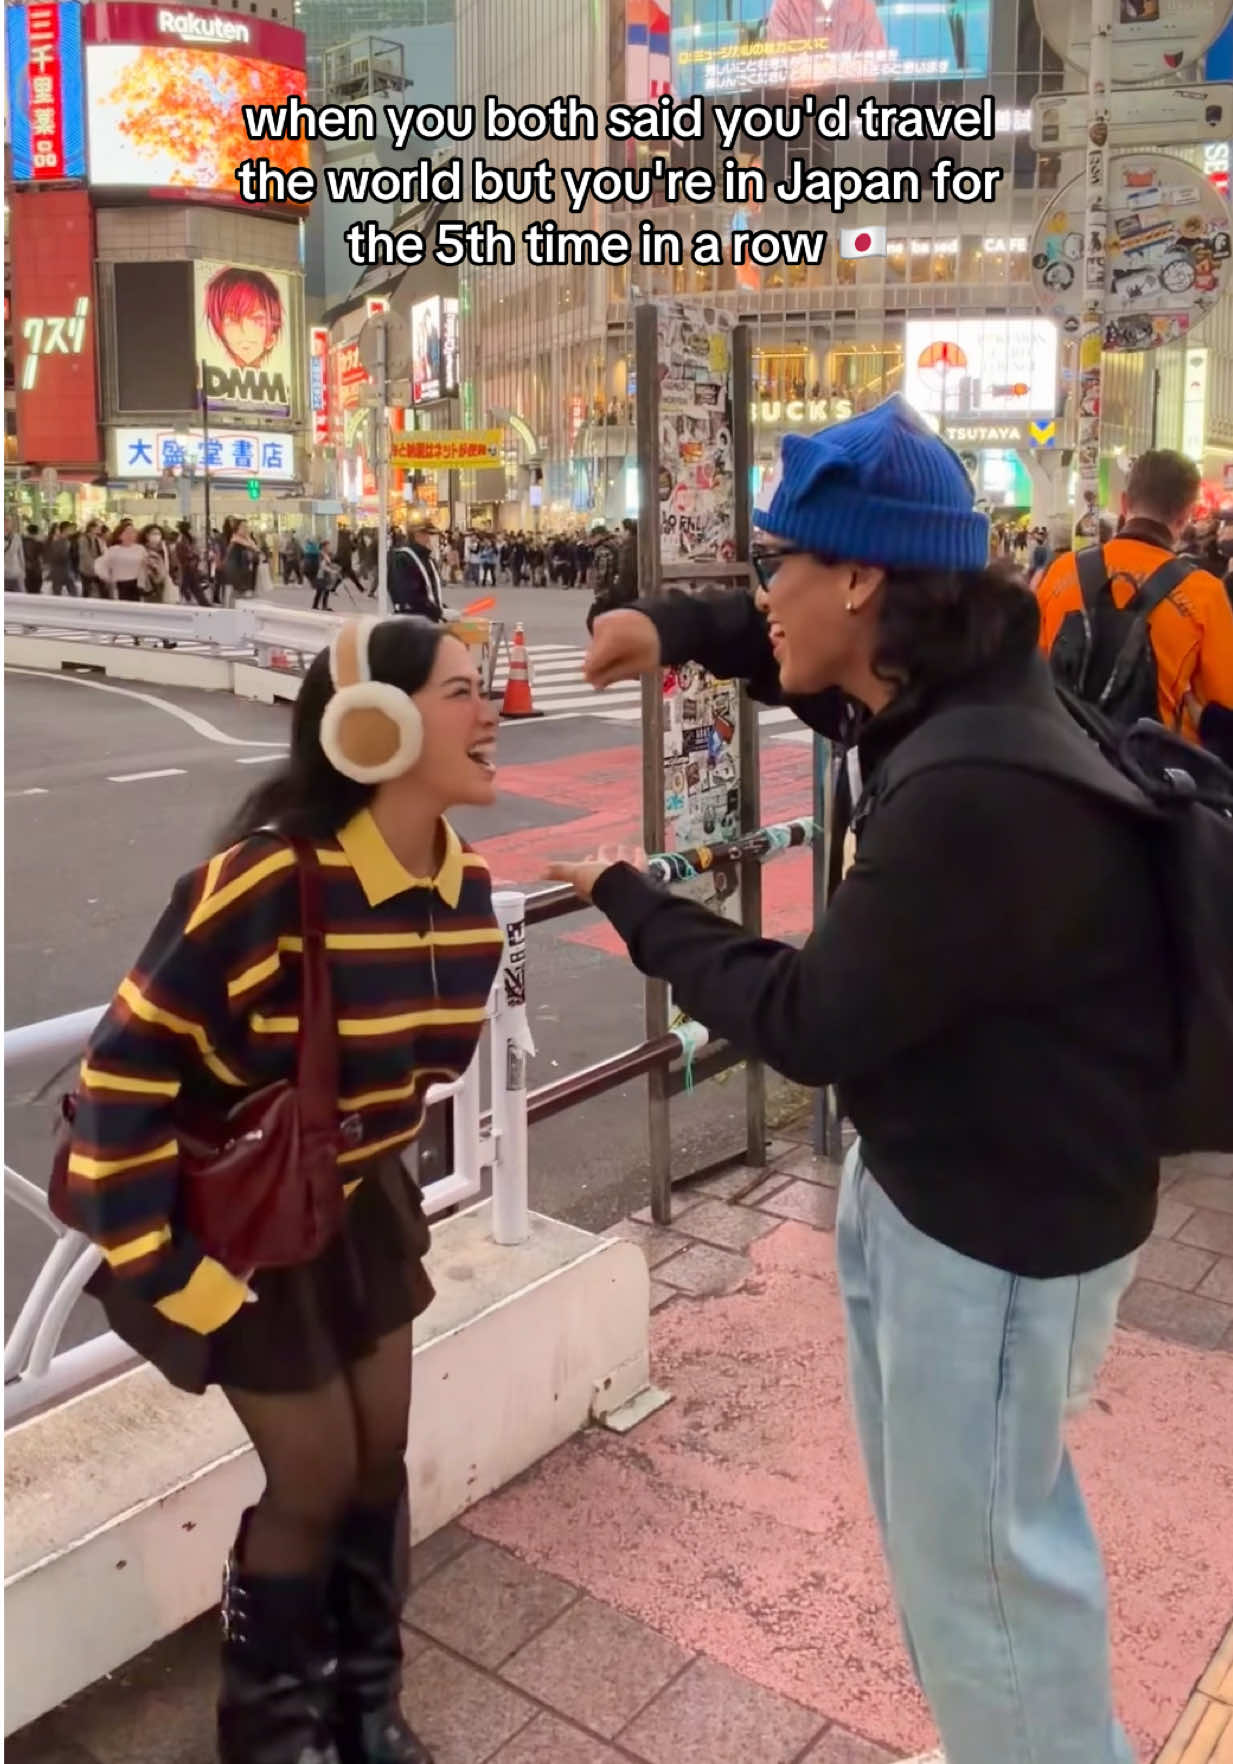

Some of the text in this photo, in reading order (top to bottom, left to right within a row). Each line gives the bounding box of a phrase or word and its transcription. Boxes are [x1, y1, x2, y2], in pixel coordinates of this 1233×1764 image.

[159, 9, 249, 43] Rakuten
[29, 8, 57, 168] 三千里薬品
[22, 296, 89, 390] クスリ
[203, 365, 287, 404] DMM
[947, 427, 1021, 441] TSUTAYA
[128, 438, 284, 468] 大盛堂書店
